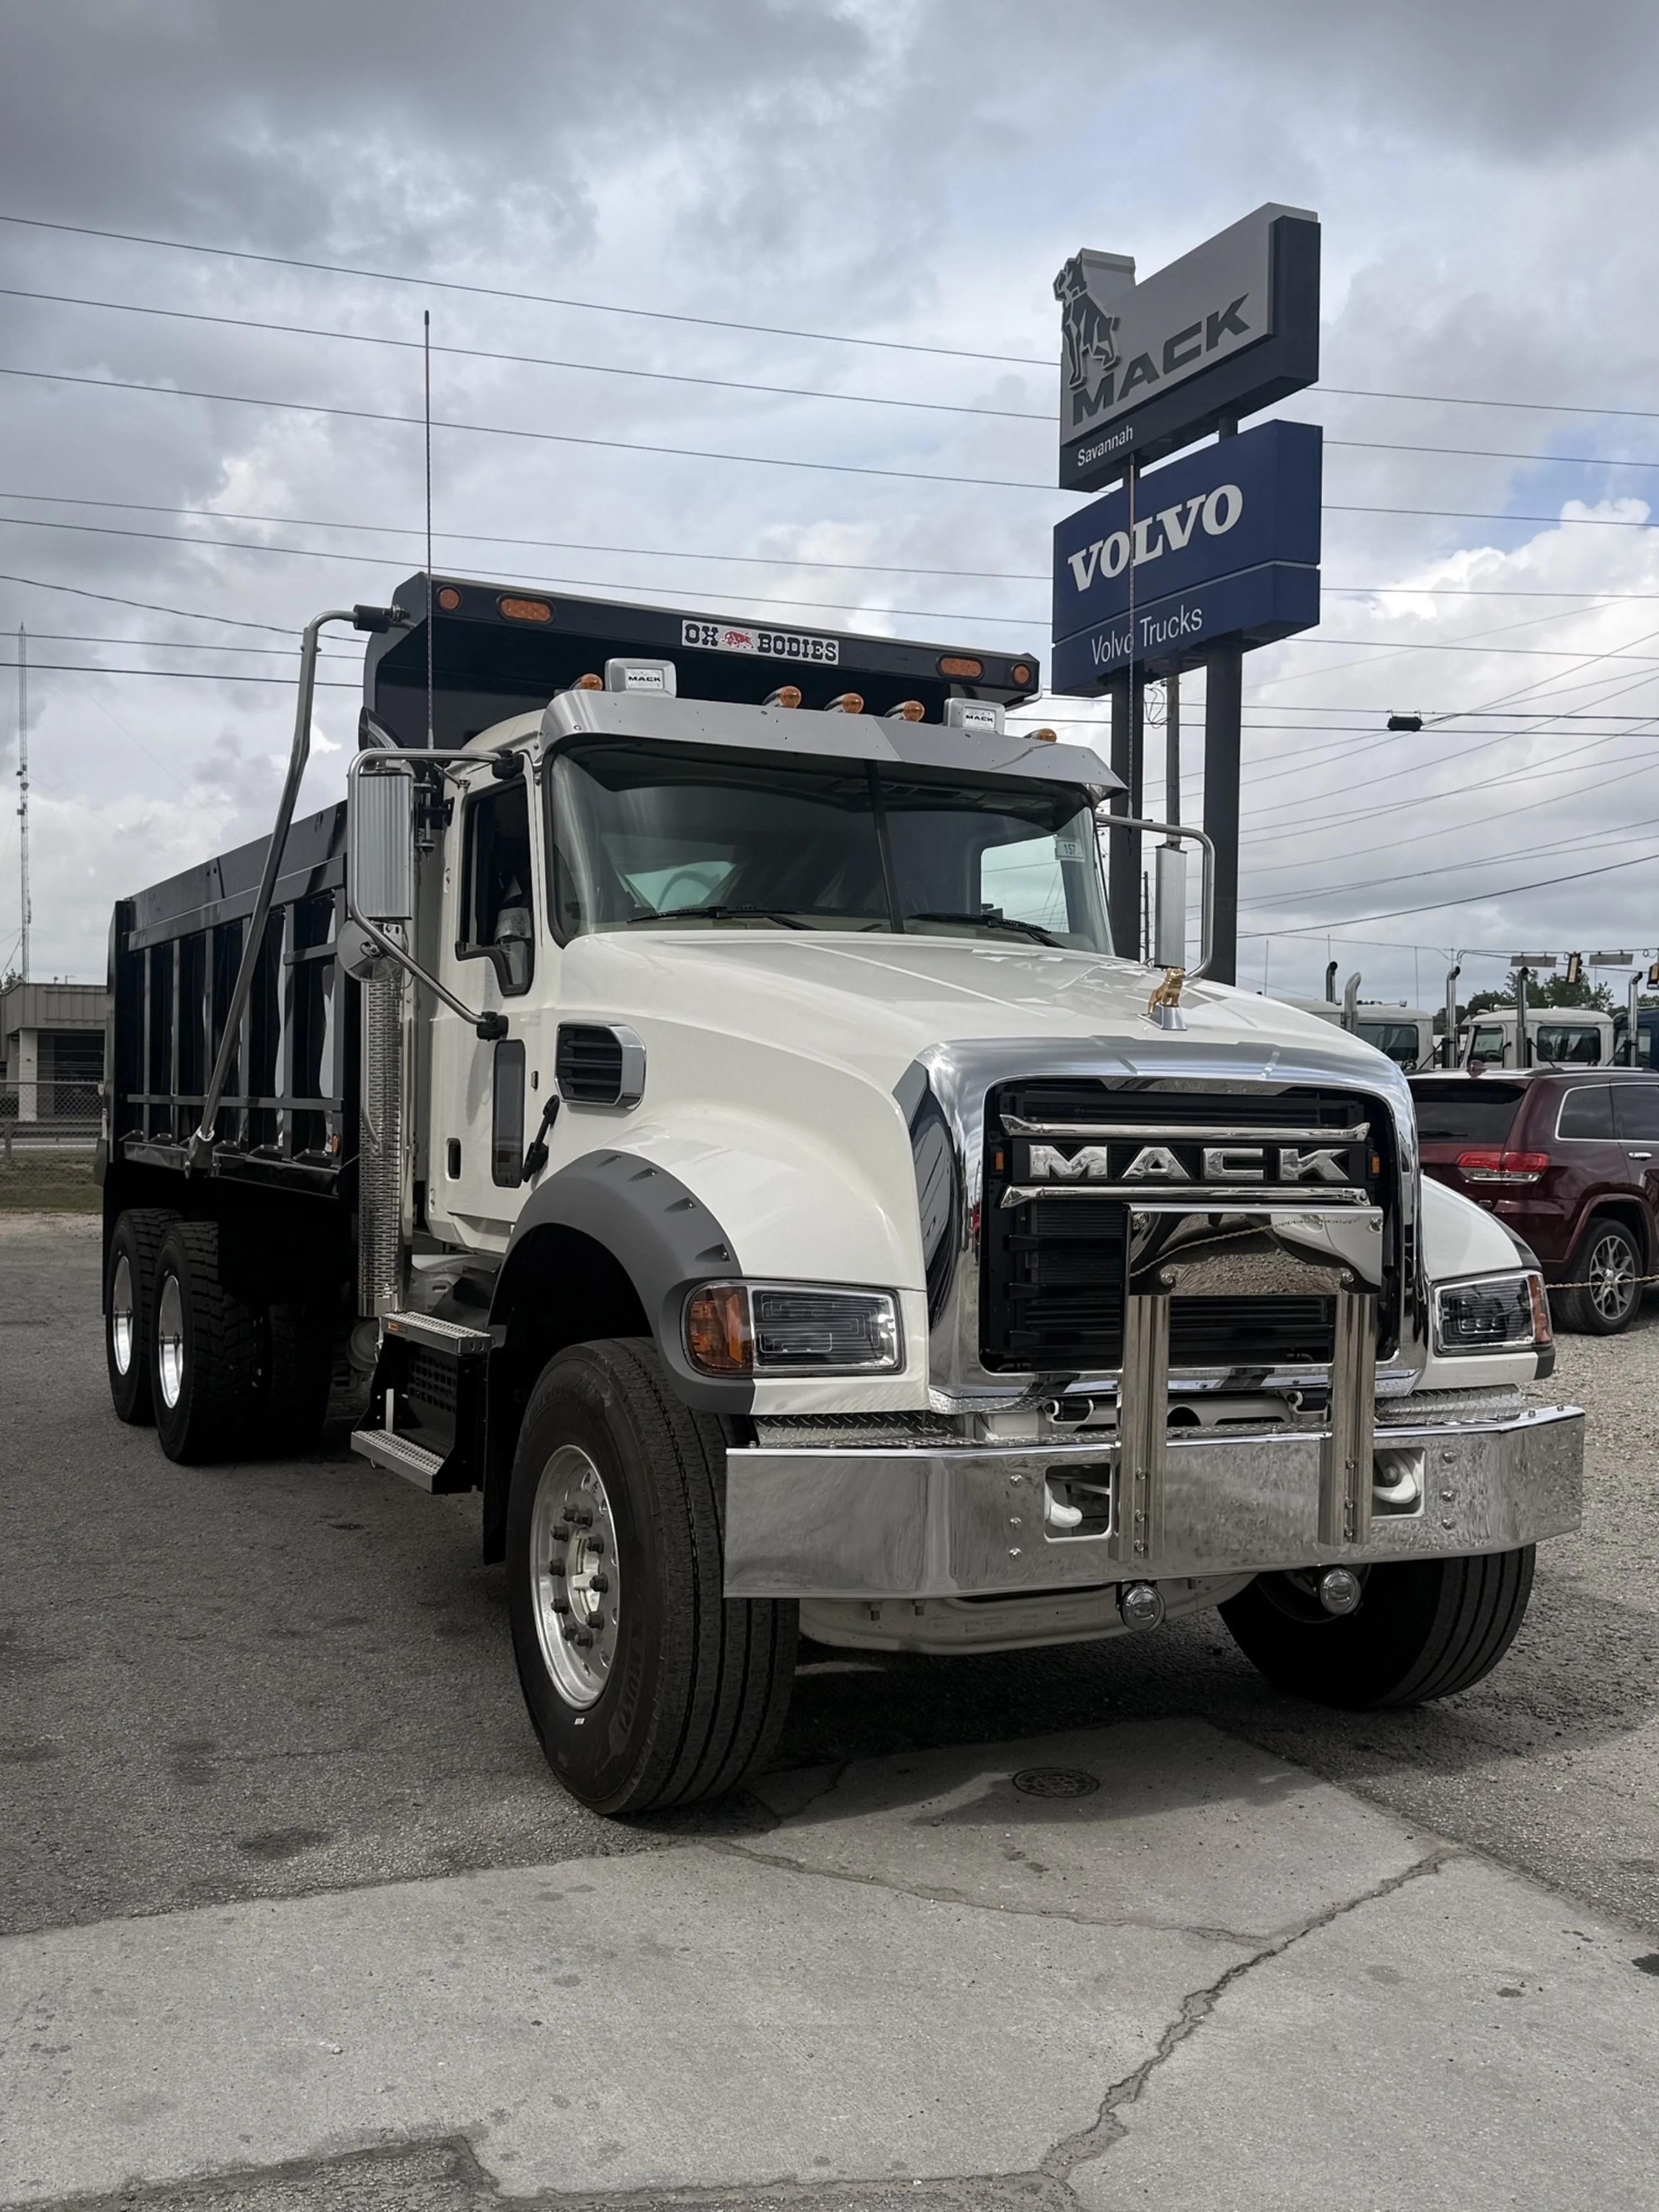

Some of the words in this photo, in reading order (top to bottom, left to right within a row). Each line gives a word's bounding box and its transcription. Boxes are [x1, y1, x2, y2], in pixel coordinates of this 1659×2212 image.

[1073, 293, 1251, 426] MACK
[1077, 425, 1134, 467] Savannah
[1067, 484, 1243, 592] VOLVO
[685, 623, 719, 646] OX
[757, 633, 837, 662] BODIES
[1091, 630, 1134, 665] Volvo
[1140, 604, 1203, 648] Trucks
[1028, 1144, 1350, 1181] MACK
